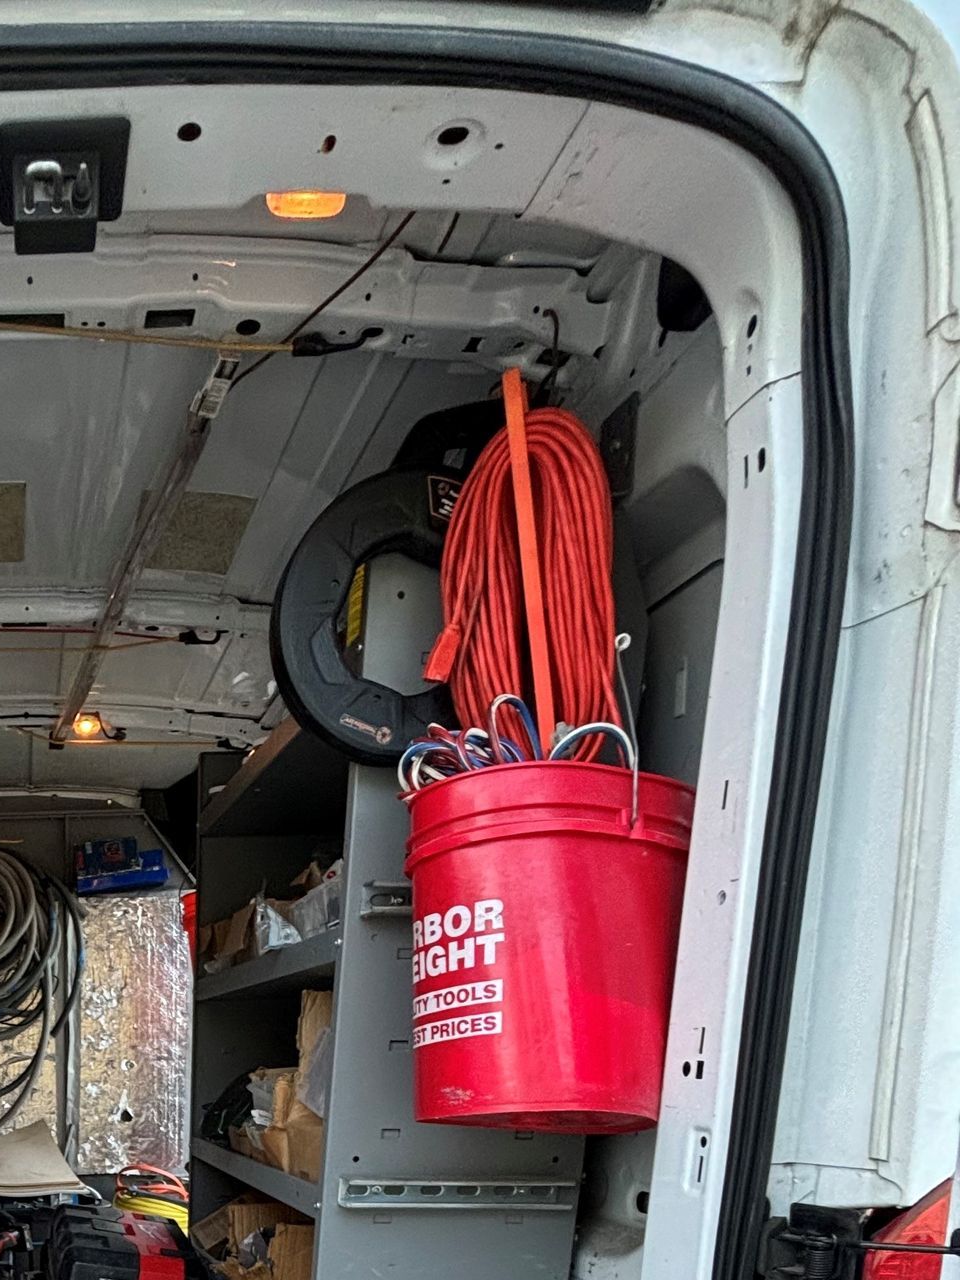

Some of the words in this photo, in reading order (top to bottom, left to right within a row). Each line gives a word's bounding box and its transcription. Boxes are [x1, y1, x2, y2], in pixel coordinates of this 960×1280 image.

[413, 899, 504, 950] RBOR
[412, 933, 505, 984] EIGHT
[433, 984, 497, 1008] TOOLS
[431, 1016, 497, 1040] PRICES
